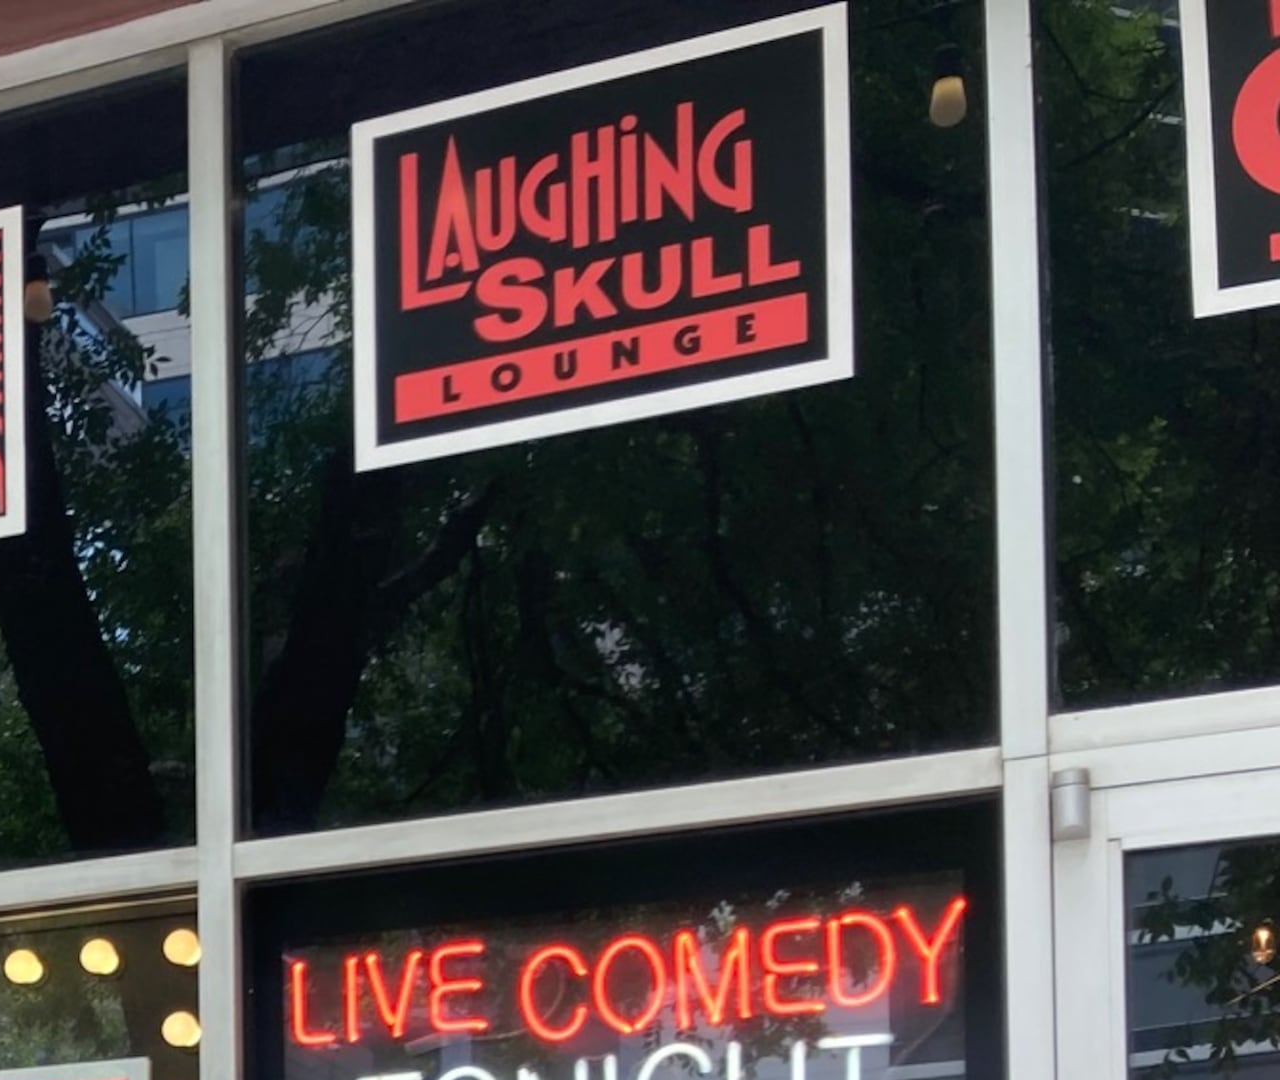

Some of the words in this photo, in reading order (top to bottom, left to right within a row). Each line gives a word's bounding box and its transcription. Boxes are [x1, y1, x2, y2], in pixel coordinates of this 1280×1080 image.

[473, 224, 801, 342] SKULL
[442, 313, 757, 403] LOUNGE
[290, 941, 488, 1045] LIVE
[520, 897, 968, 1043] COMEDY
